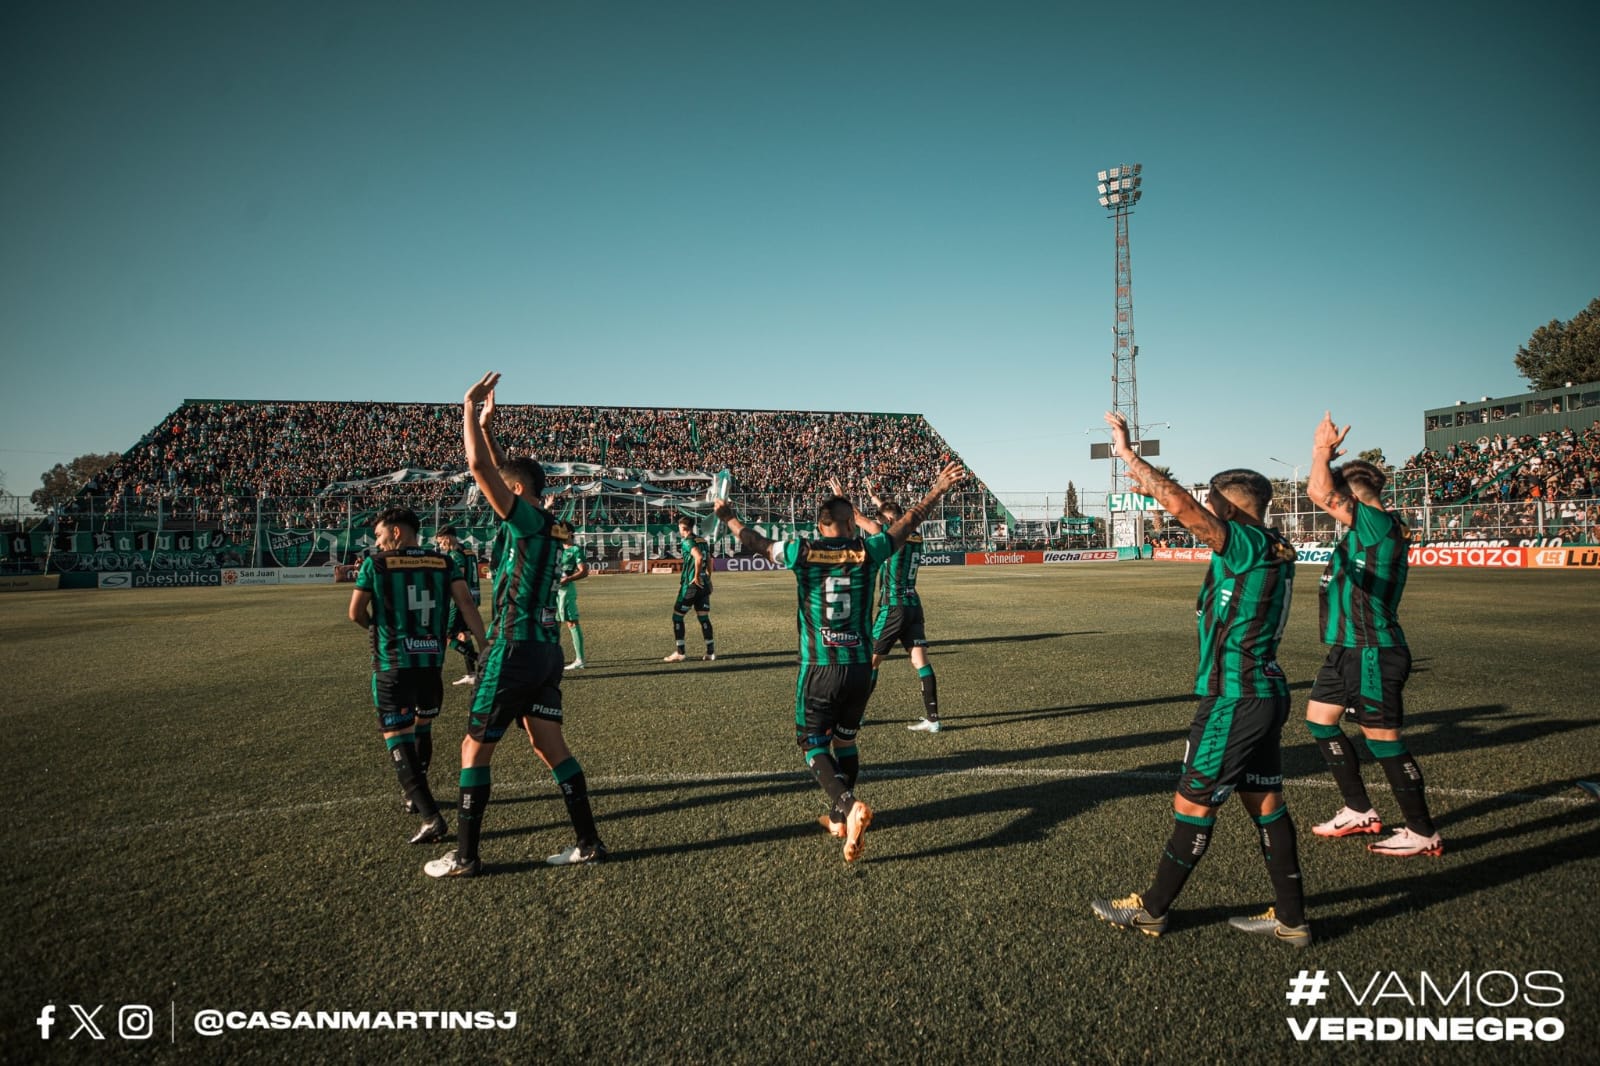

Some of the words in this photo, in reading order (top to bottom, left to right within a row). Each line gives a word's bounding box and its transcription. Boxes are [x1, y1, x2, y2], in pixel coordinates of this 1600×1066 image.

[1110, 493, 1145, 511] SAN
[271, 534, 289, 545] SAN
[272, 535, 309, 550] MARTIN
[920, 554, 951, 567] Sports
[984, 552, 1025, 565] Schneider
[1567, 549, 1600, 566] LÜ
[135, 570, 220, 587] pbestatica
[239, 570, 255, 578] San
[256, 570, 275, 578] Juan
[407, 585, 436, 627] 4
[825, 576, 851, 620] 5
[1246, 773, 1283, 785] Piazz
[1192, 833, 1207, 856] mitre
